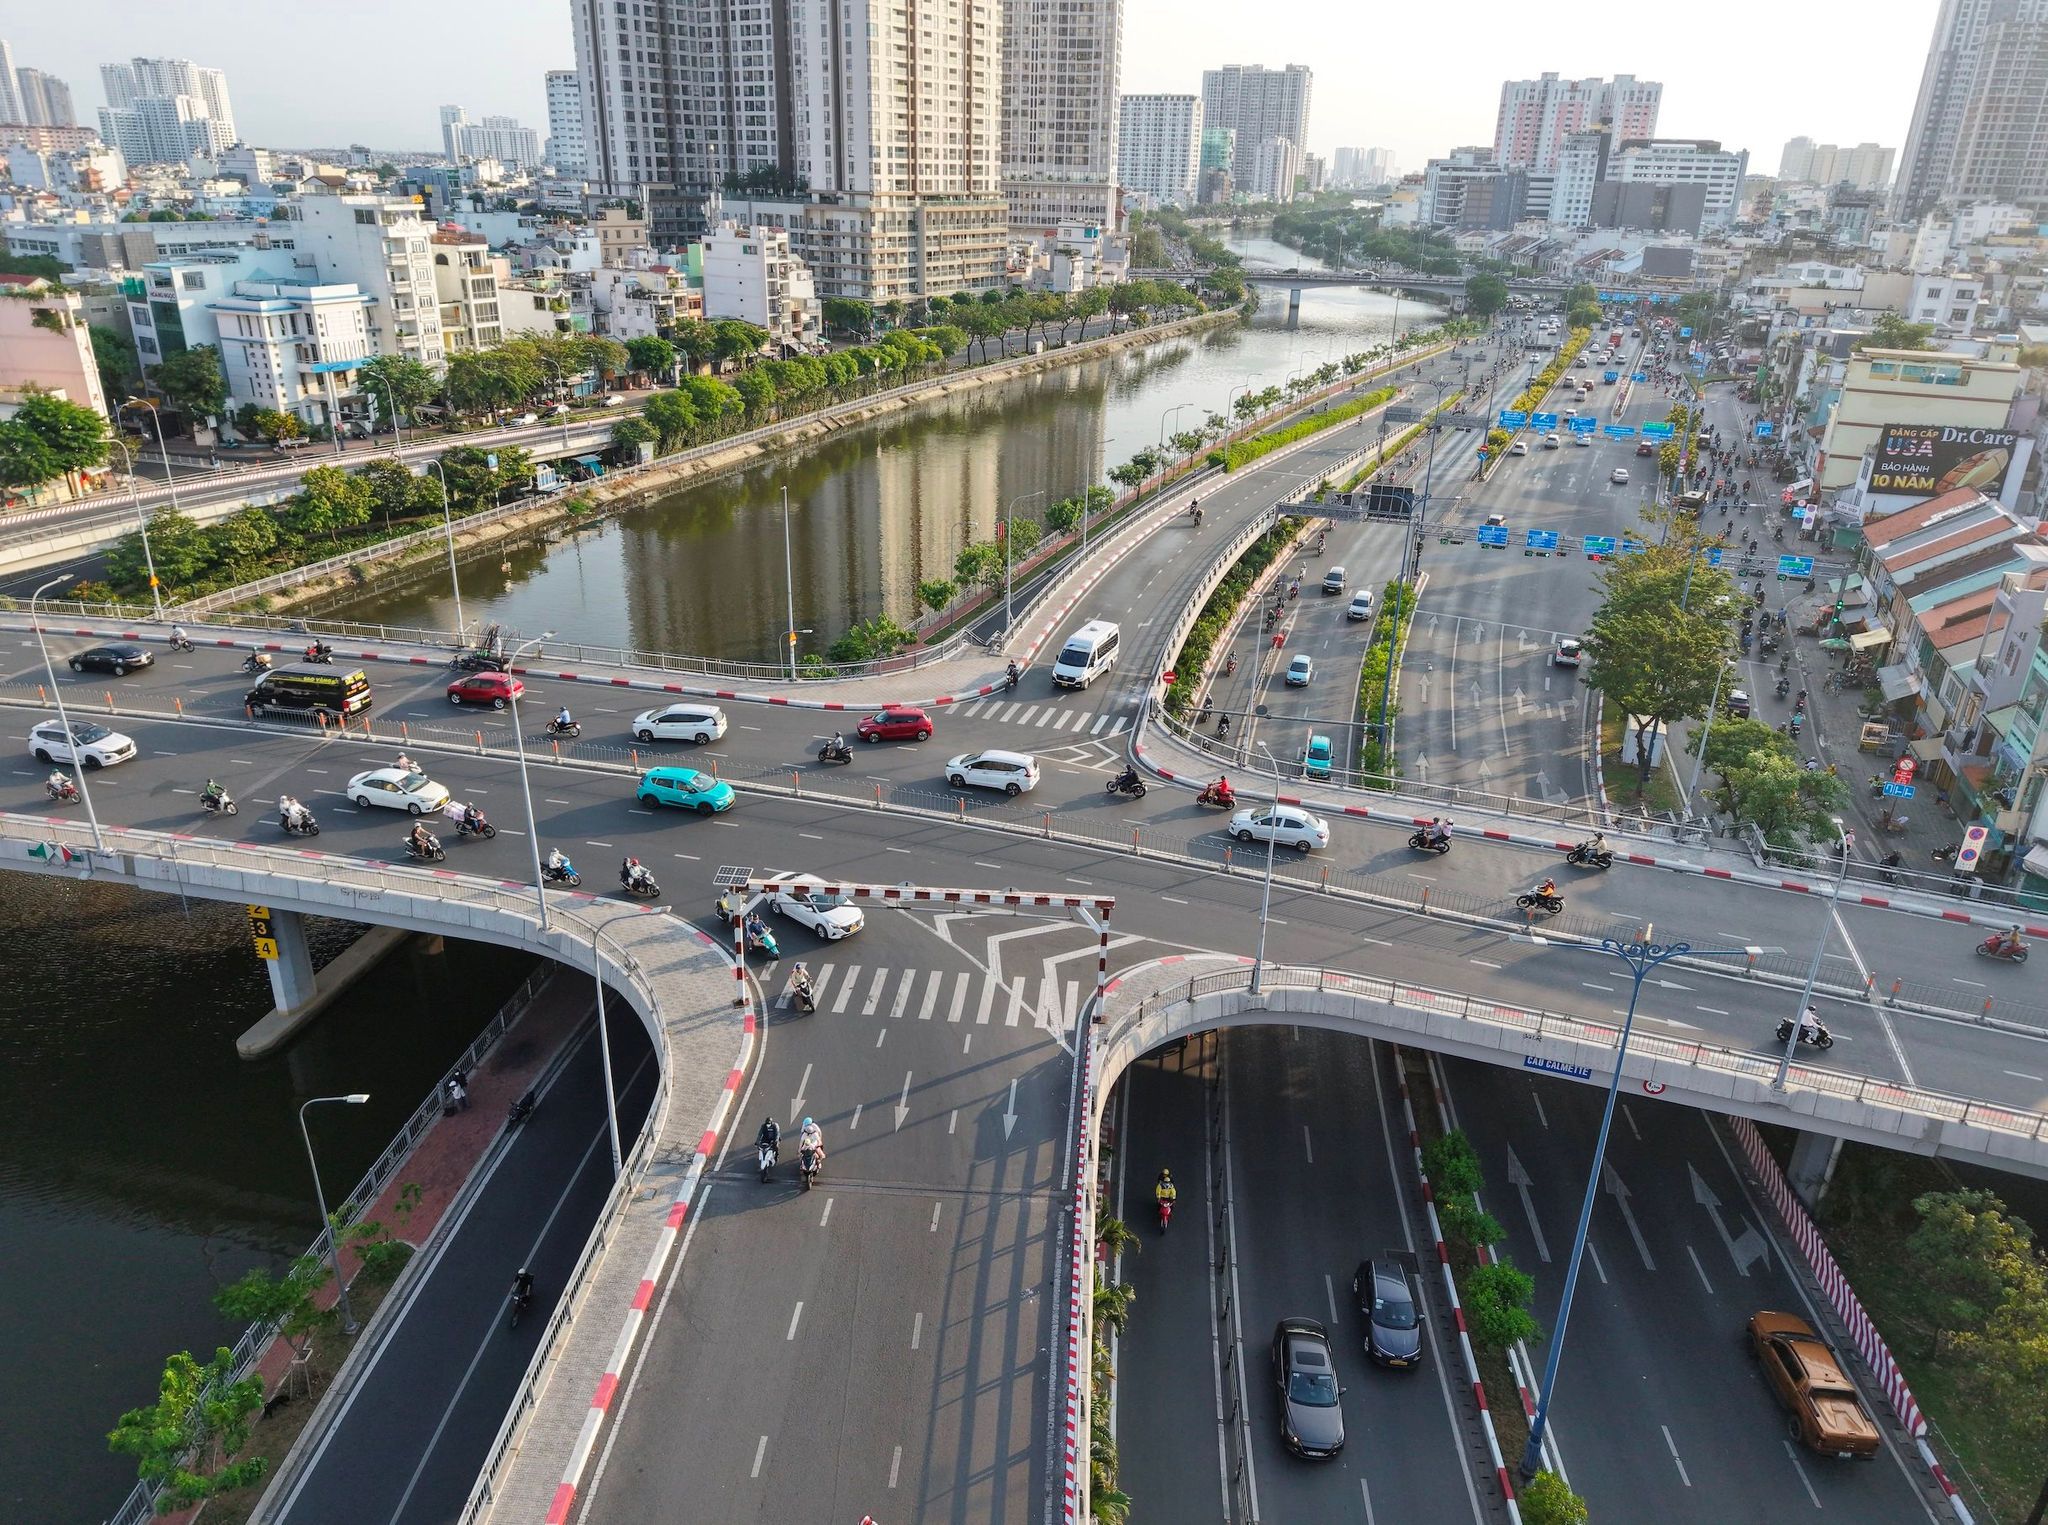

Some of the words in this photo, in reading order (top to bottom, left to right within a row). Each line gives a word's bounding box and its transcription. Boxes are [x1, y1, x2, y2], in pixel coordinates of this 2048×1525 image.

[1940, 427, 2014, 446] Dr.Care
[1886, 436, 1933, 457] USA
[1881, 461, 1902, 471] BẢO
[1902, 463, 1930, 473] HÀNH
[1872, 474, 1890, 487] 10
[1893, 472, 1936, 490] NĂM
[256, 921, 267, 935] 3
[262, 942, 272, 955] 4
[1546, 1060, 1589, 1076] CALMETTE
